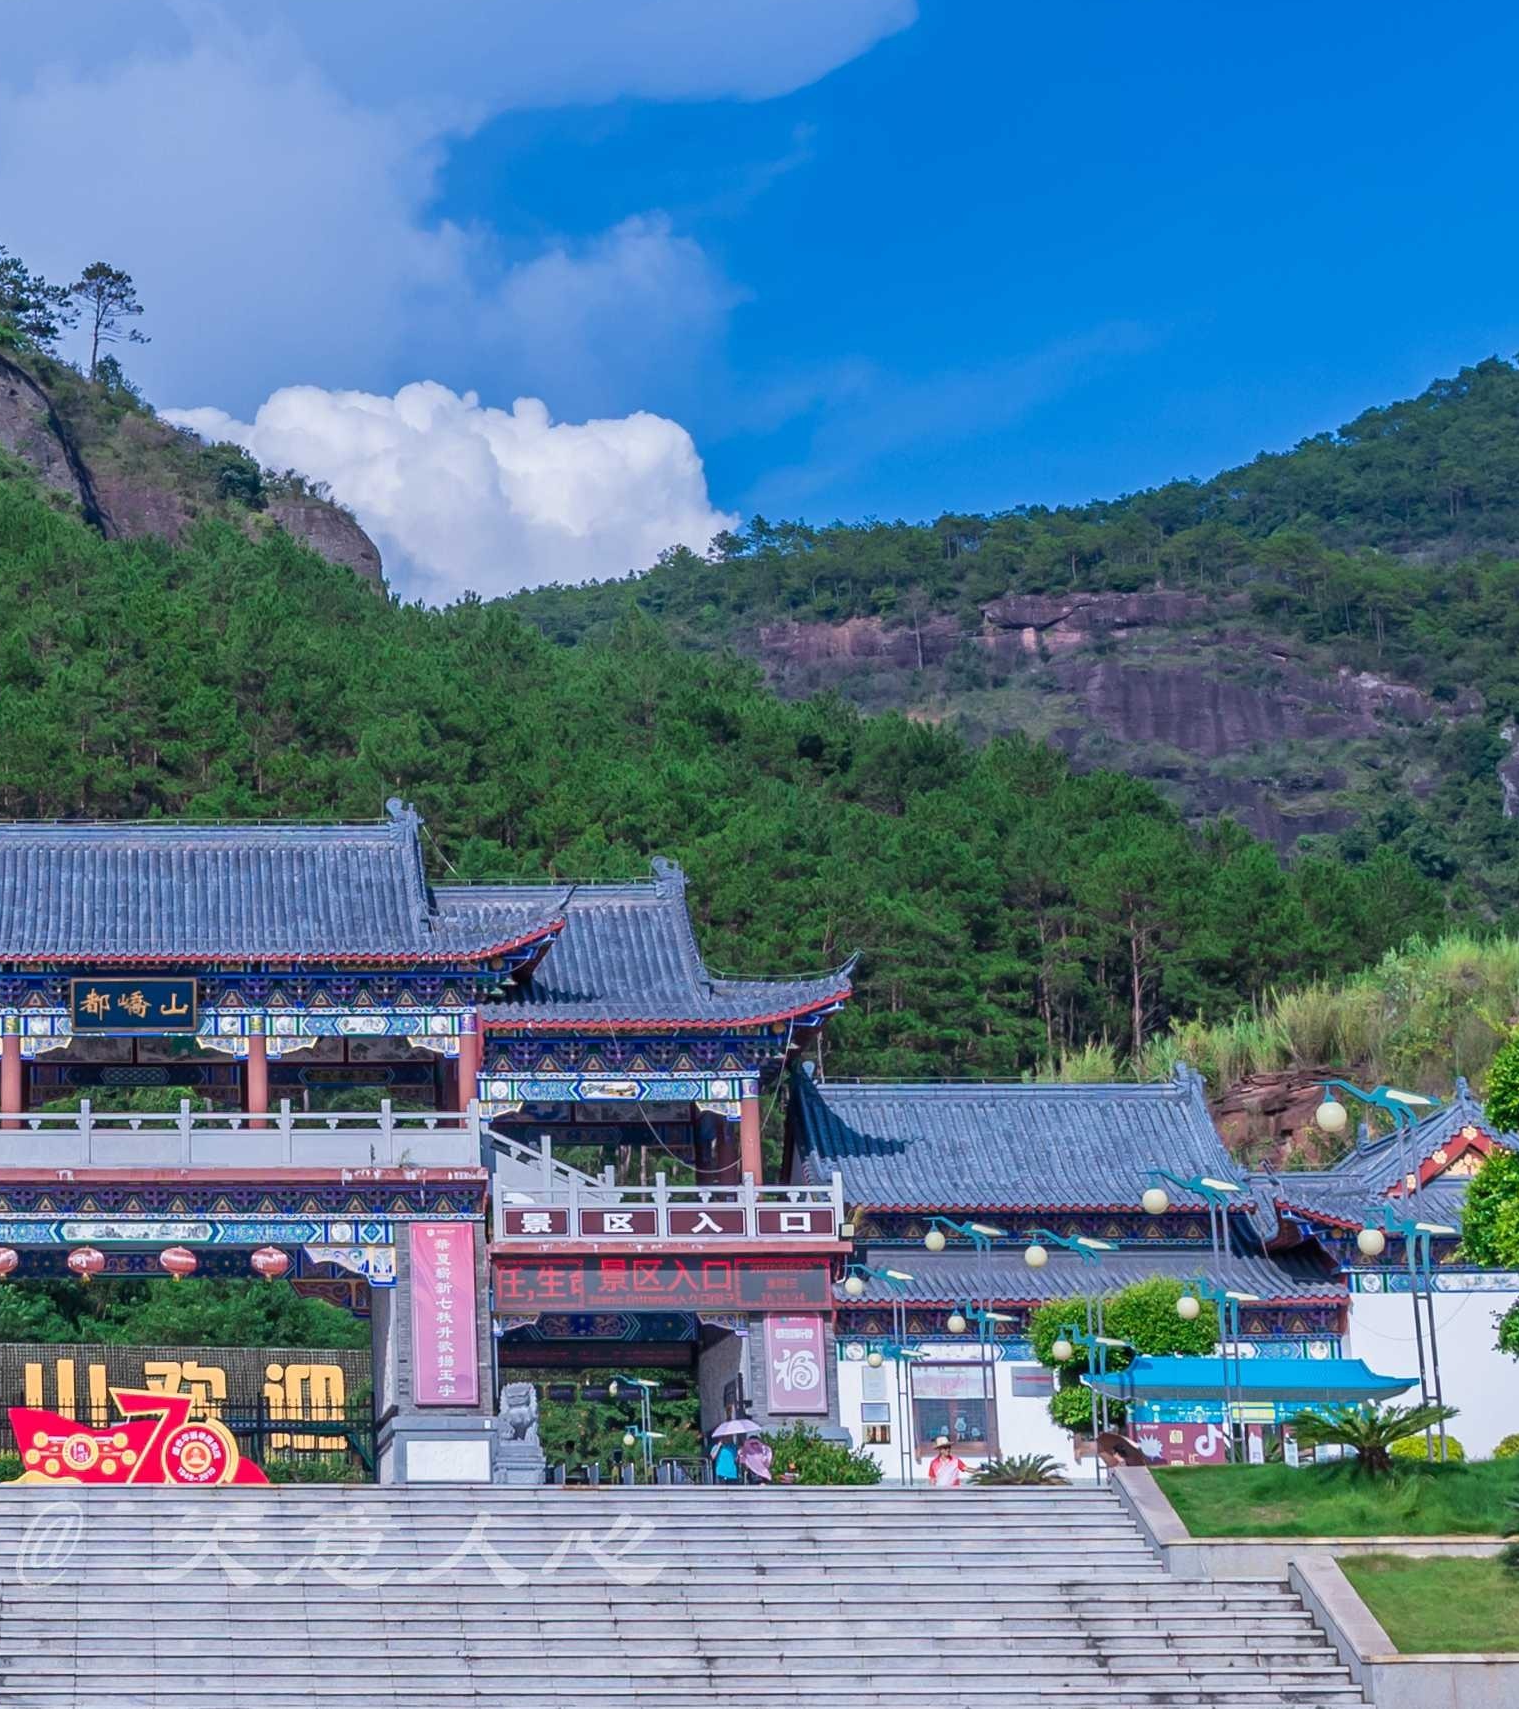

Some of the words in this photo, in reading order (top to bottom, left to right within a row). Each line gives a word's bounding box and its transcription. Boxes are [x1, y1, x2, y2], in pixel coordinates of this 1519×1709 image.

[520, 1211, 811, 1233] 景区入口
[597, 1258, 732, 1291] 景区入口
[773, 1349, 820, 1391] 福
